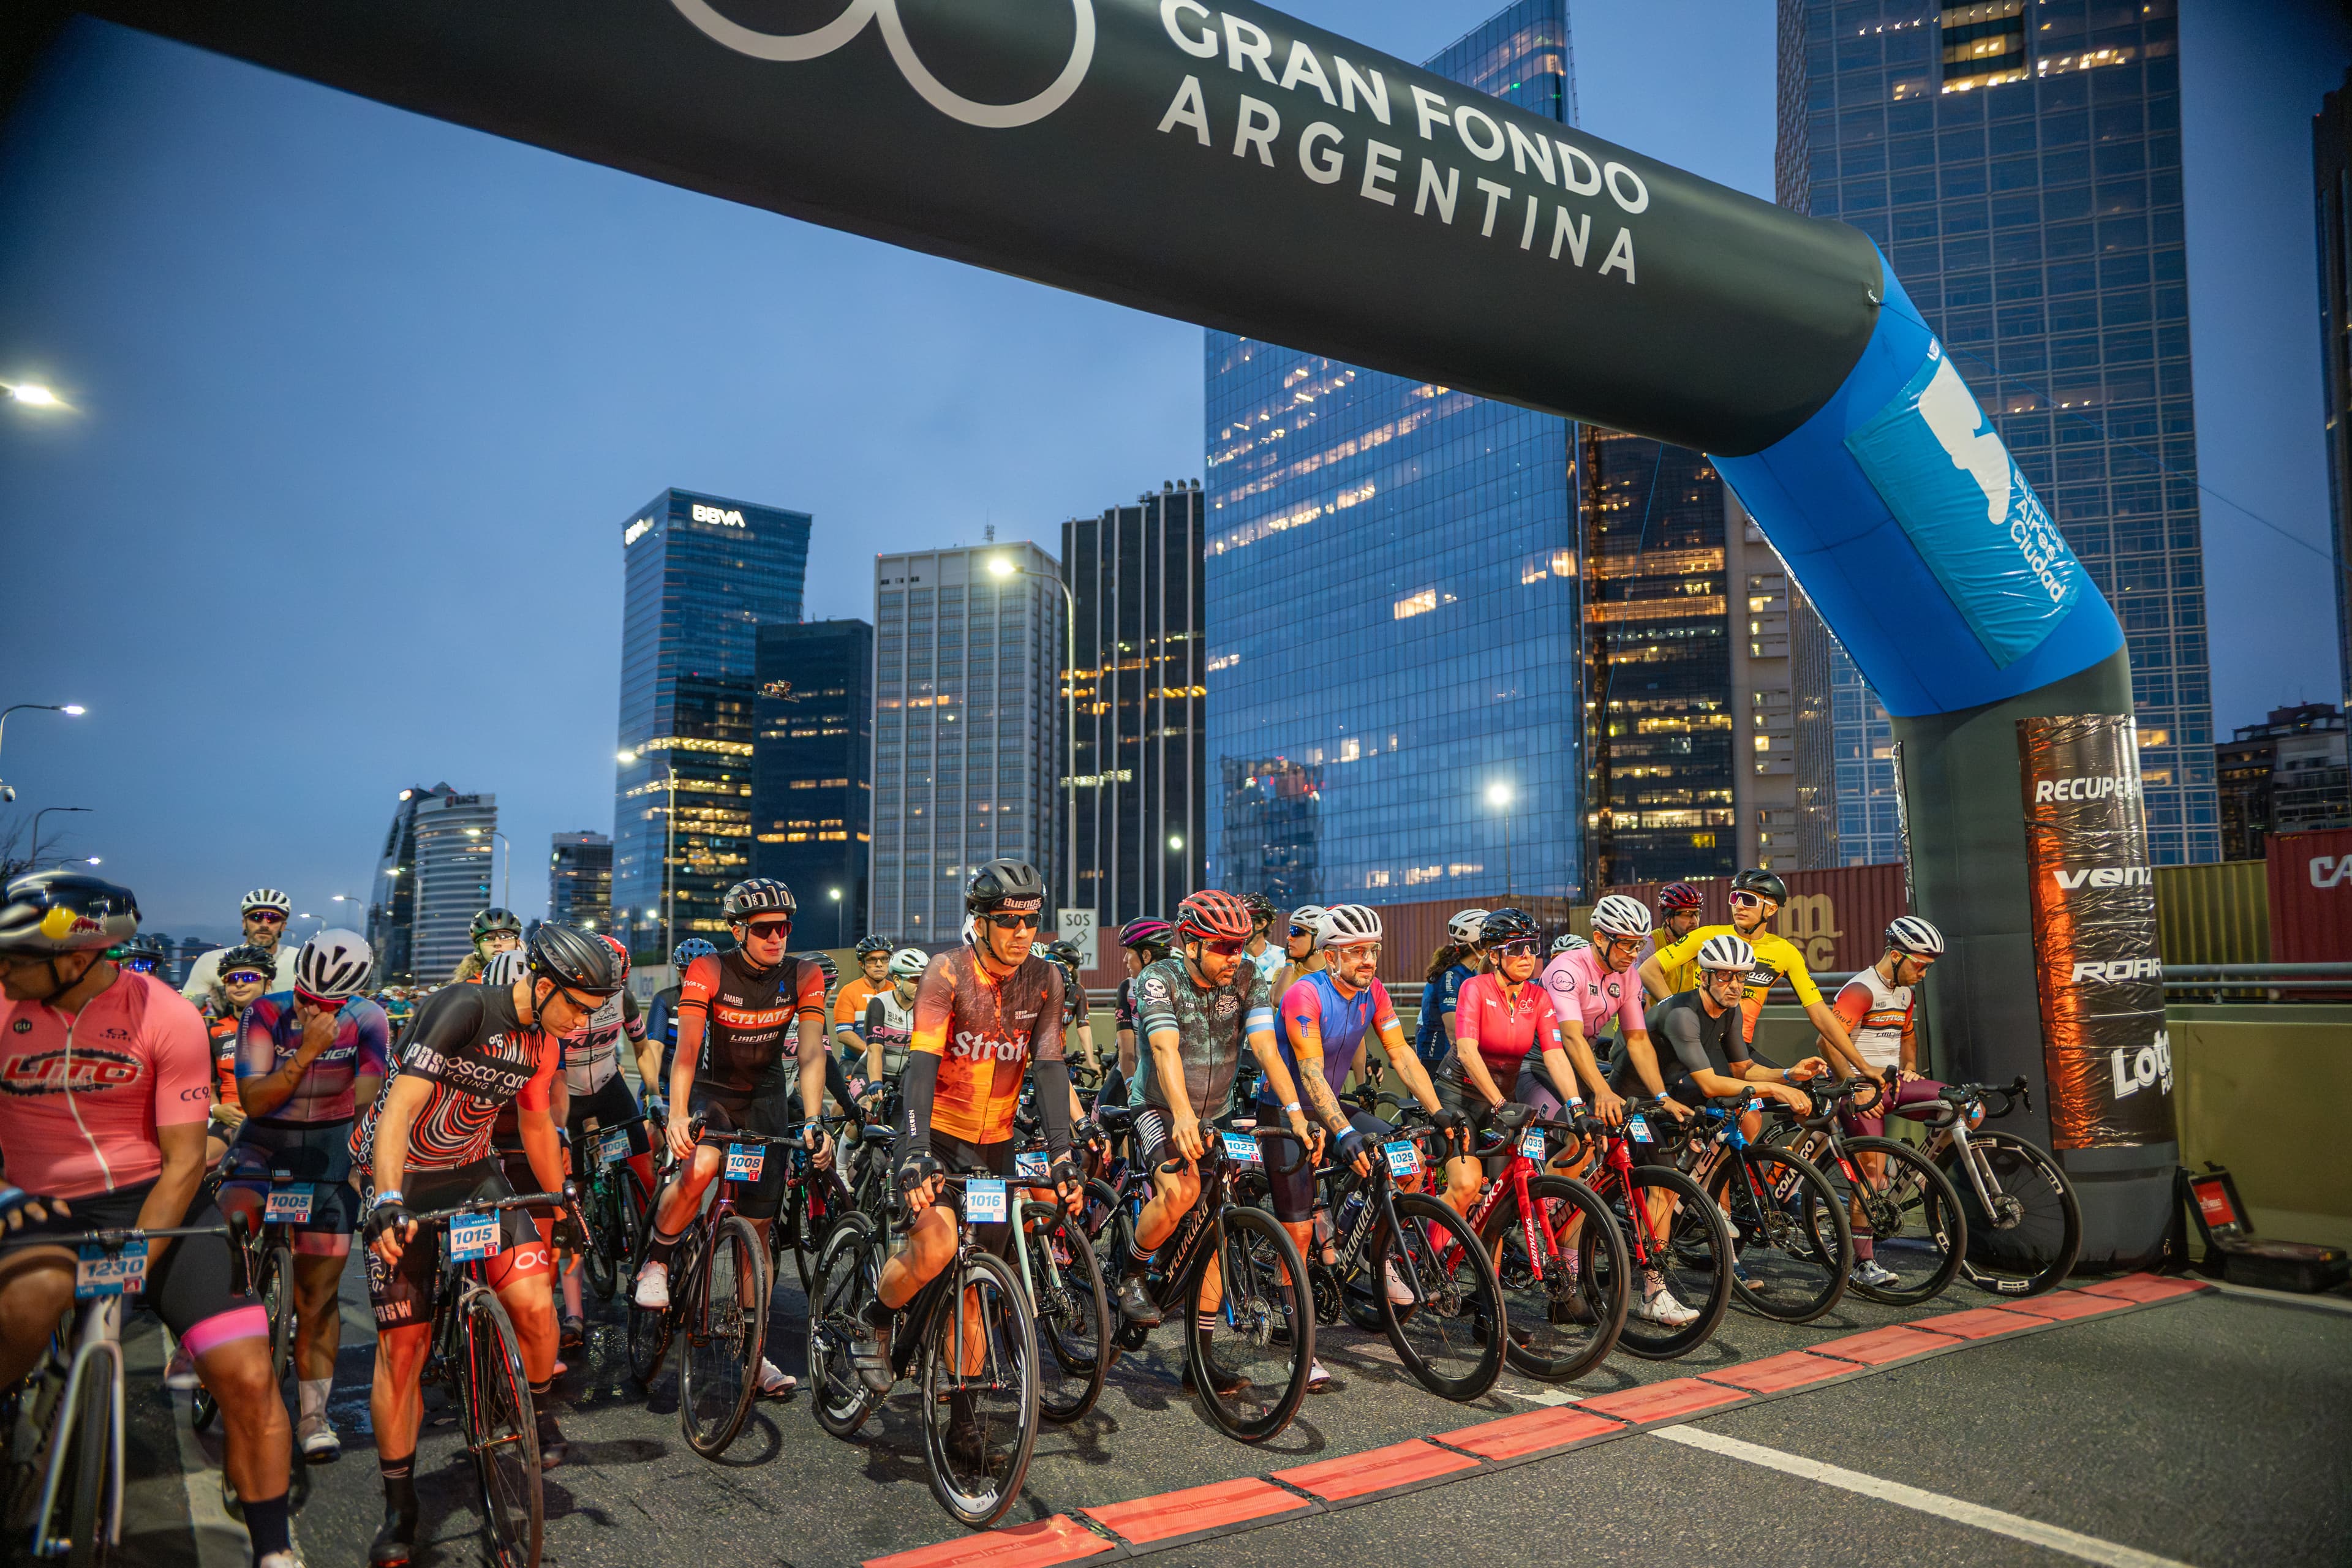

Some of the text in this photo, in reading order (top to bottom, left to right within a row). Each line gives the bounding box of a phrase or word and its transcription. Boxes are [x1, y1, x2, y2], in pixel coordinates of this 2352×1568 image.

[1161, 0, 1391, 126] GRAN
[1411, 85, 1649, 214] FONDO
[1156, 74, 1636, 285] ARGENTINA
[692, 503, 746, 528] BBVA
[2010, 520, 2067, 603] Ciudad
[1065, 914, 1091, 926] SOS
[1896, 928, 1915, 945] TREK
[723, 993, 744, 1005] AMARU
[717, 1008, 791, 1025] ACTIVATE
[564, 1028, 618, 1049] KTM
[951, 1030, 1028, 1062] Strat
[1630, 1124, 1645, 1133] 1011
[1227, 1142, 1256, 1152] 1023
[1525, 1136, 1542, 1148] 1033
[730, 1156, 761, 1168] 1008
[1390, 1152, 1414, 1164] 1029
[1839, 1159, 1853, 1181] Emirates
[271, 1196, 309, 1208] 1005
[970, 1195, 1001, 1207] 1016
[454, 1227, 492, 1245] 1015
[1165, 1200, 1209, 1283] SPECIALIZED
[1337, 1196, 1375, 1276] SPECIALIZED
[1525, 1215, 1540, 1268] SPECIALIZED
